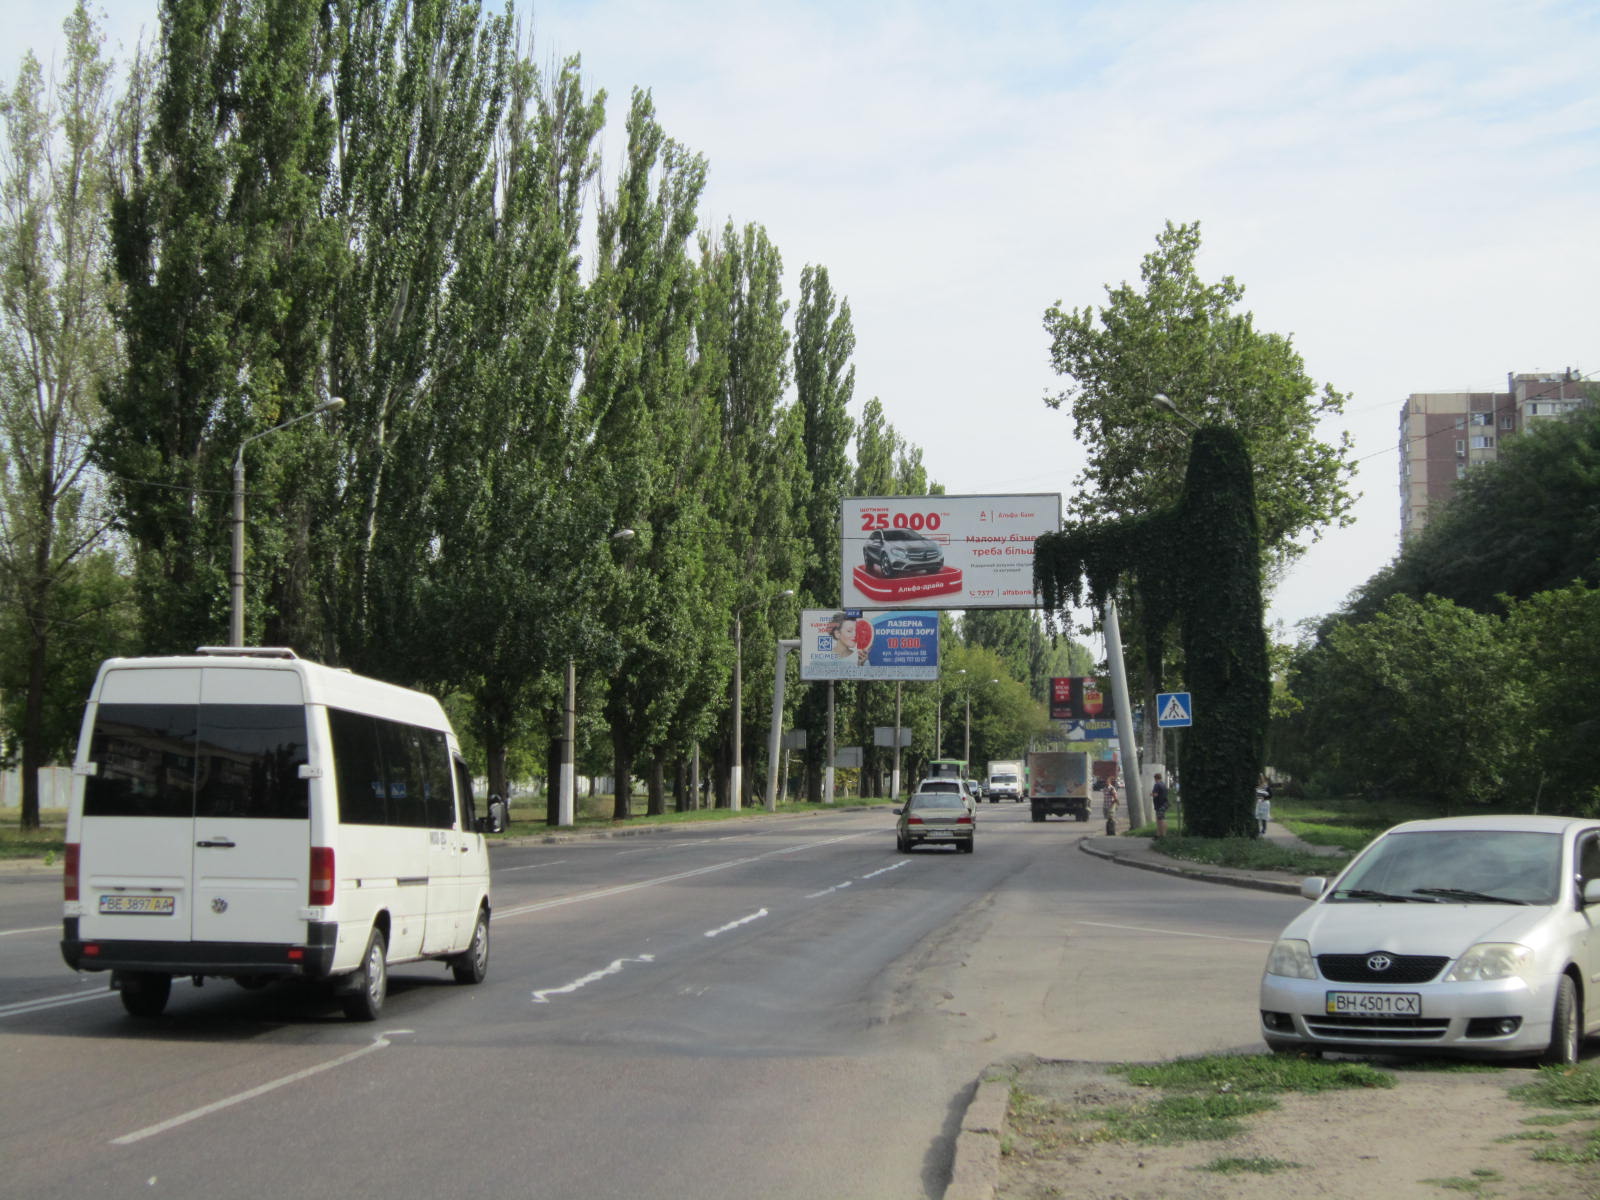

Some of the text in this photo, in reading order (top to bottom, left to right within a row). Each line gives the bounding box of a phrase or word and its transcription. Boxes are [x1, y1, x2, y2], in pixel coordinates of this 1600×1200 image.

[861, 512, 941, 531] 25 000
[966, 534, 1039, 544] Малому бізне
[972, 546, 1037, 557] треба більш
[898, 582, 944, 593] Альфа-драйв
[875, 628, 914, 636] КОРЕКЦІЯ
[1336, 995, 1416, 1012] BH 4501 CX
